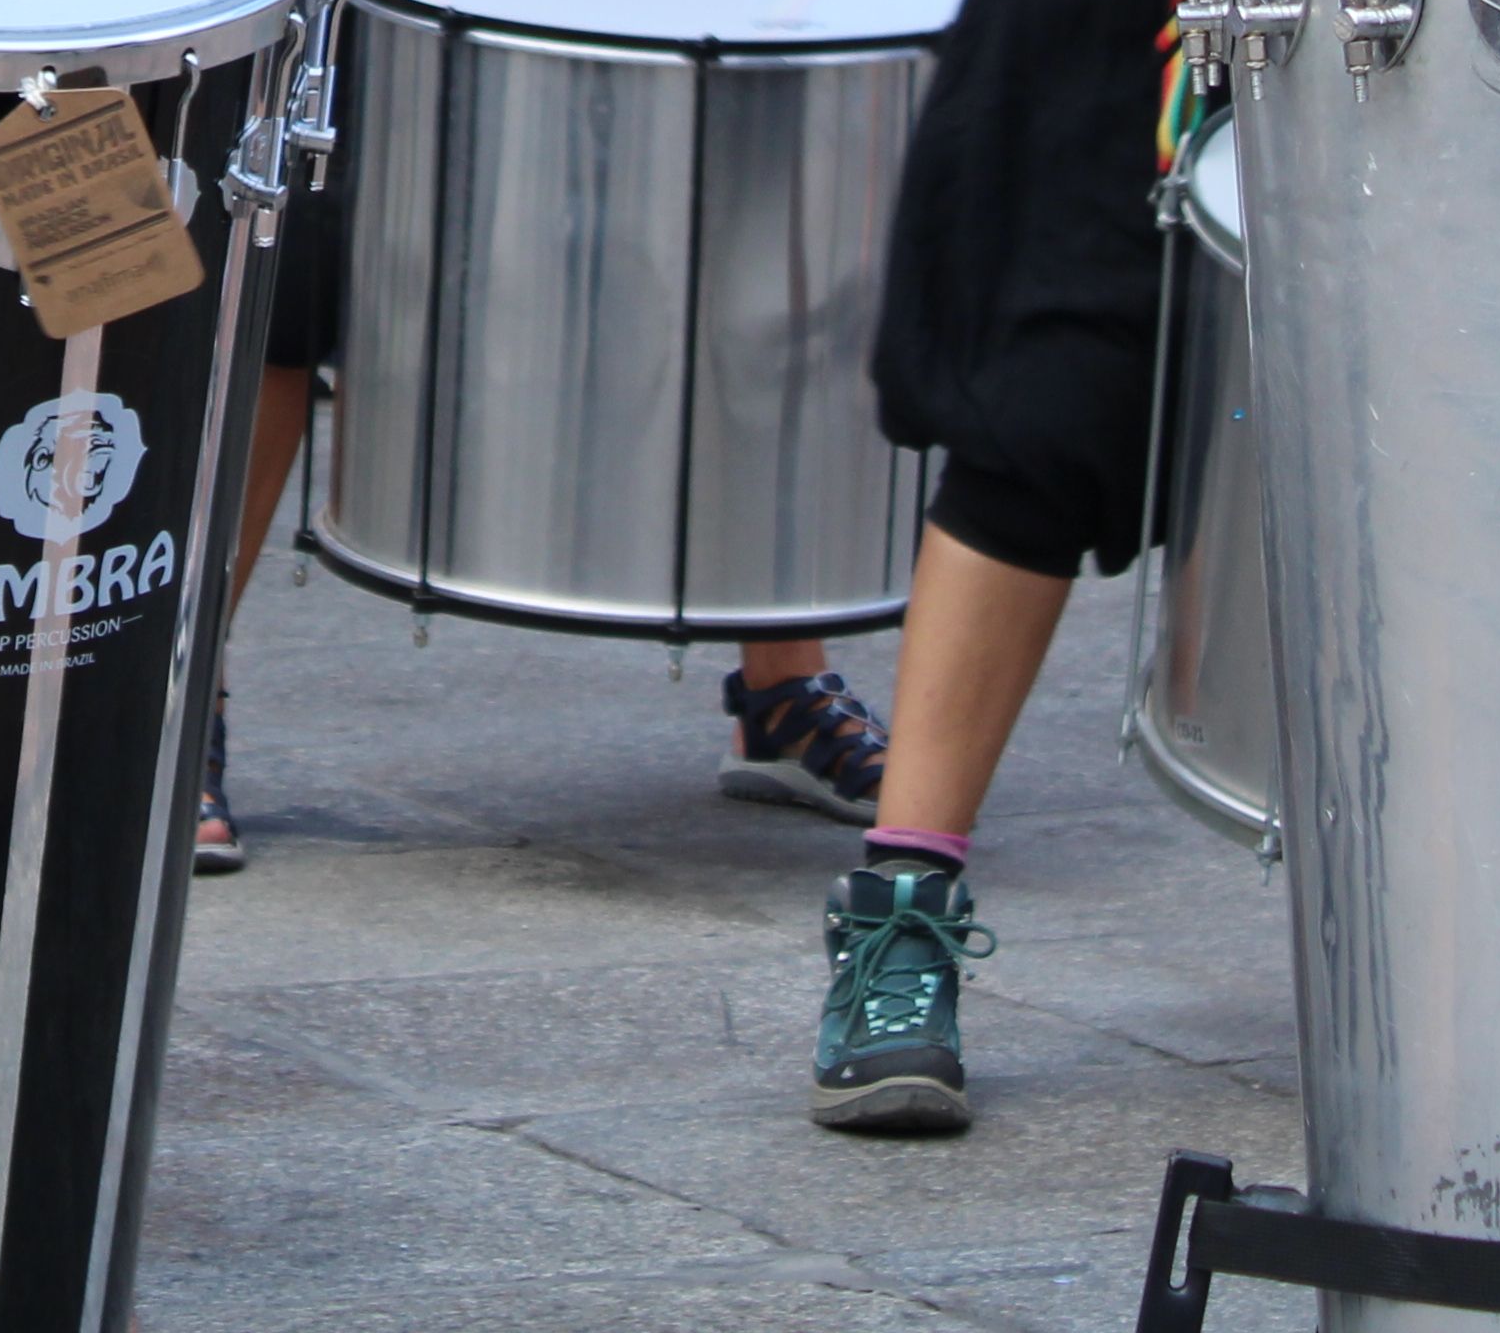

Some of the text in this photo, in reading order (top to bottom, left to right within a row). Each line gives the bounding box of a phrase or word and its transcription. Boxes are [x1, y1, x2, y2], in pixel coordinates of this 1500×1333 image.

[15, 616, 122, 651] PERCUSSION
[0, 652, 96, 677] MADE IN BRAZIL
